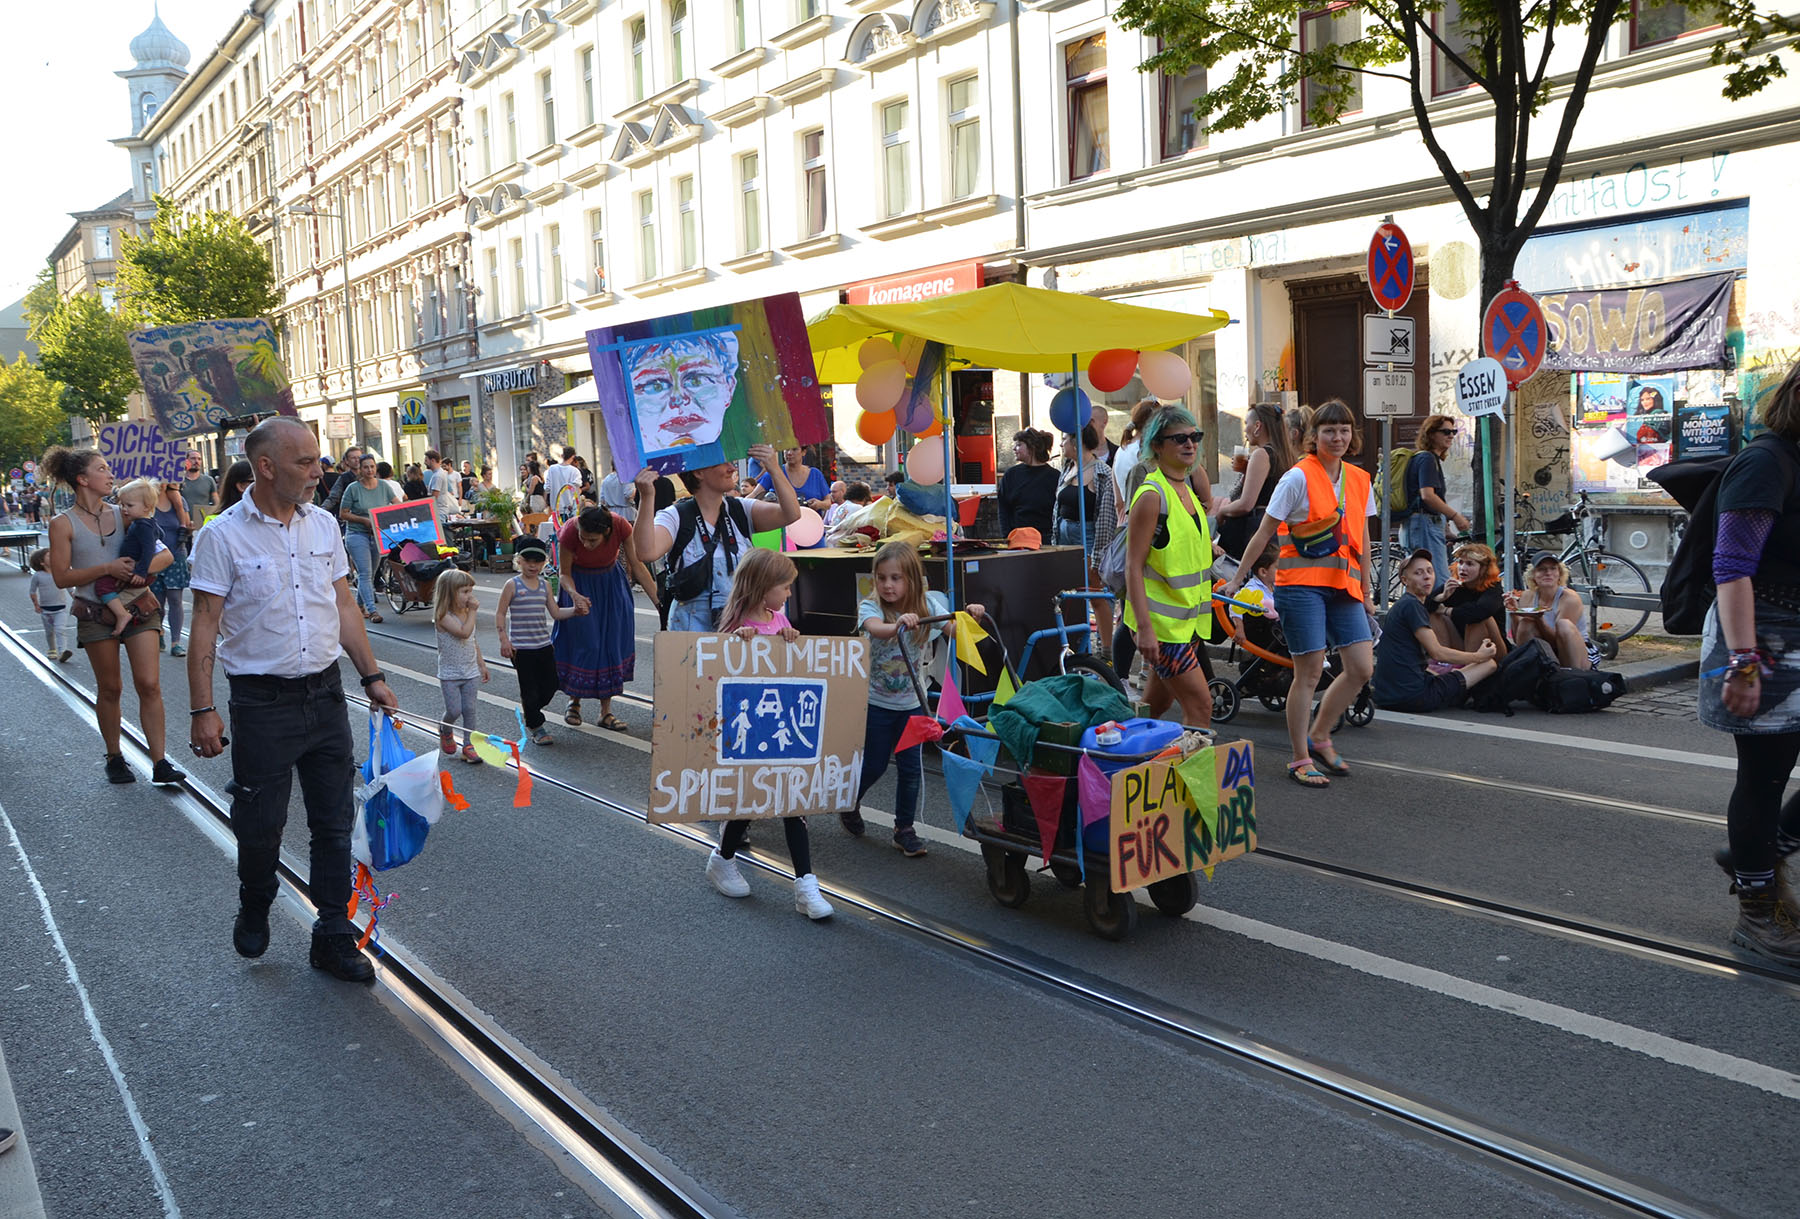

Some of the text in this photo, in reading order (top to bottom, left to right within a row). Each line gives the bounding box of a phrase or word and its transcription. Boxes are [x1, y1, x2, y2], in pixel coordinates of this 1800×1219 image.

[1543, 156, 1690, 219] ntifaOst
[867, 276, 955, 305] komagene
[1459, 369, 1496, 400] ESSEN
[1382, 400, 1397, 412] Demo
[1682, 426, 1726, 437] WITHOUT
[1683, 418, 1724, 429] MONDAY
[1694, 435, 1714, 444] YOU
[107, 455, 187, 483] HULWEGE
[696, 635, 867, 679] FÜR MEHR
[1124, 743, 1255, 829] PLA DA
[1117, 813, 1180, 888] FÜR
